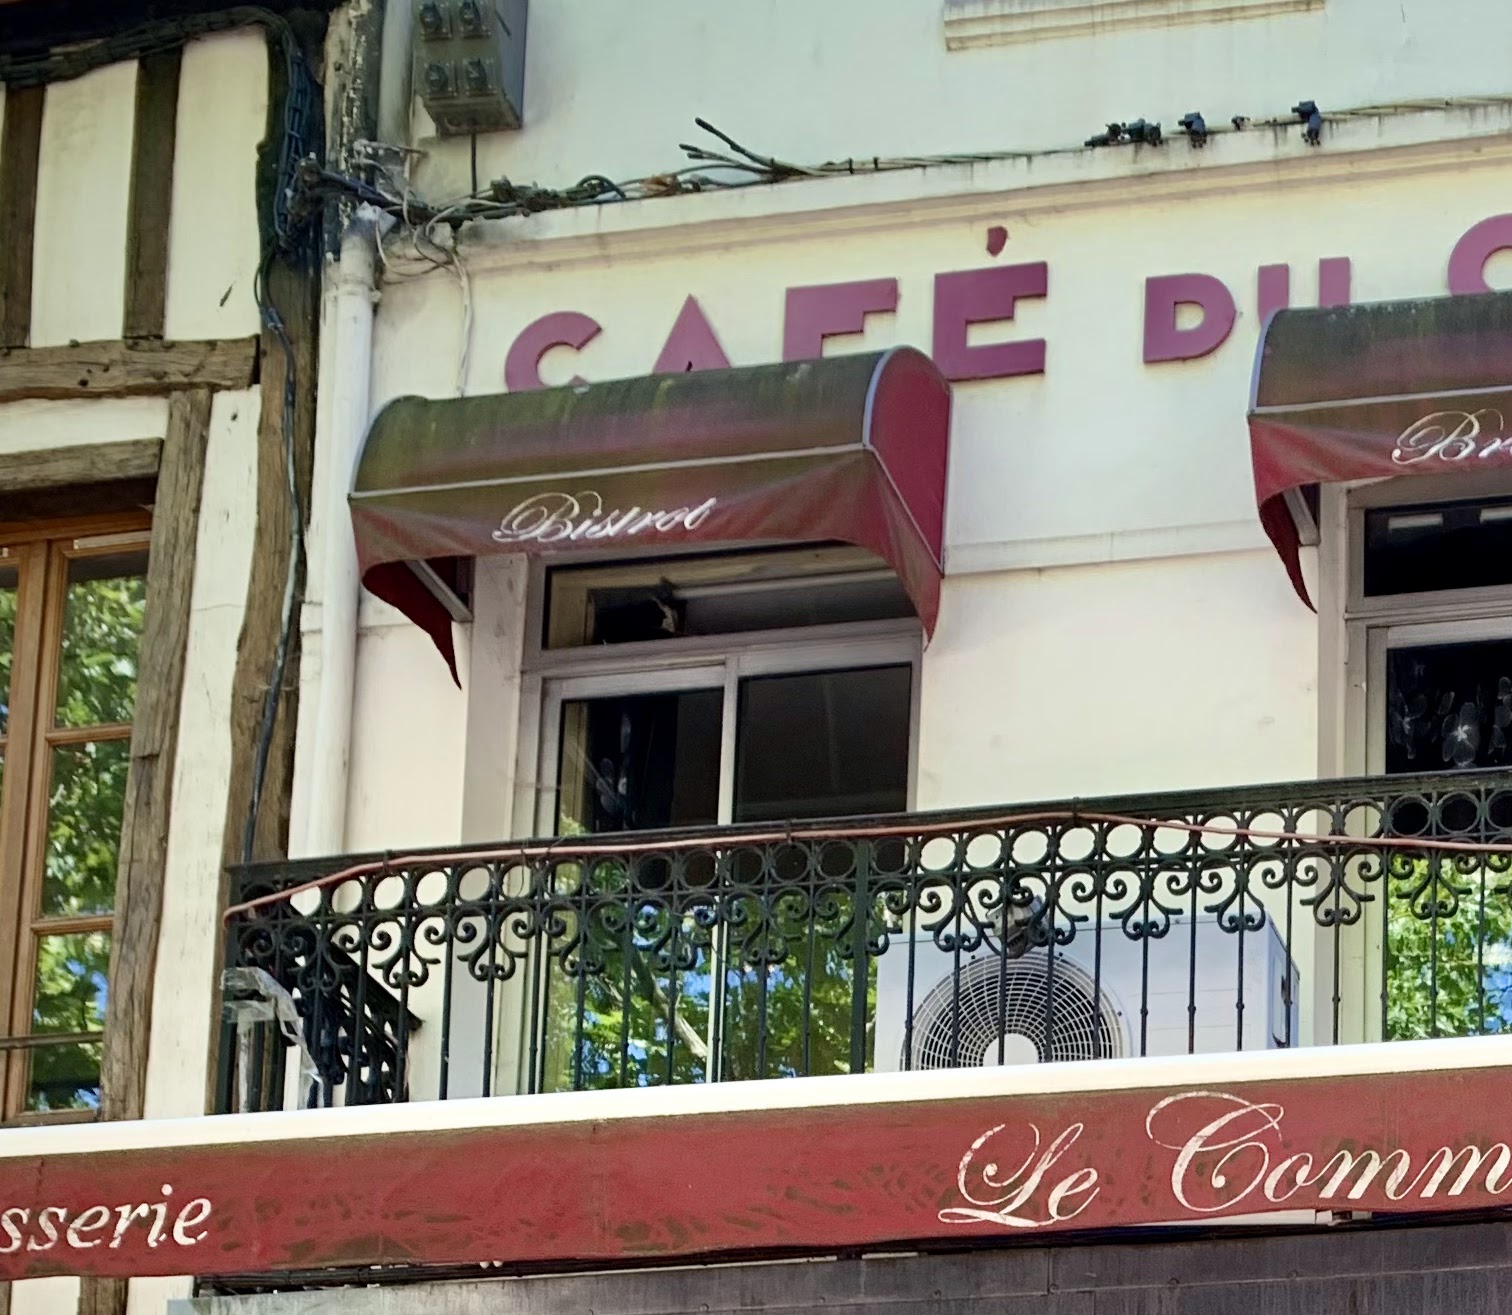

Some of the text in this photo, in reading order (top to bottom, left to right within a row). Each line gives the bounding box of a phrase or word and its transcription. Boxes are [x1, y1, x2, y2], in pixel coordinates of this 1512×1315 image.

[504, 225, 1049, 393] CAFÉ
[1143, 256, 1351, 364] DU
[491, 490, 717, 543] Bistrot
[0, 1183, 213, 1253] sserie
[937, 1122, 1101, 1228] Le
